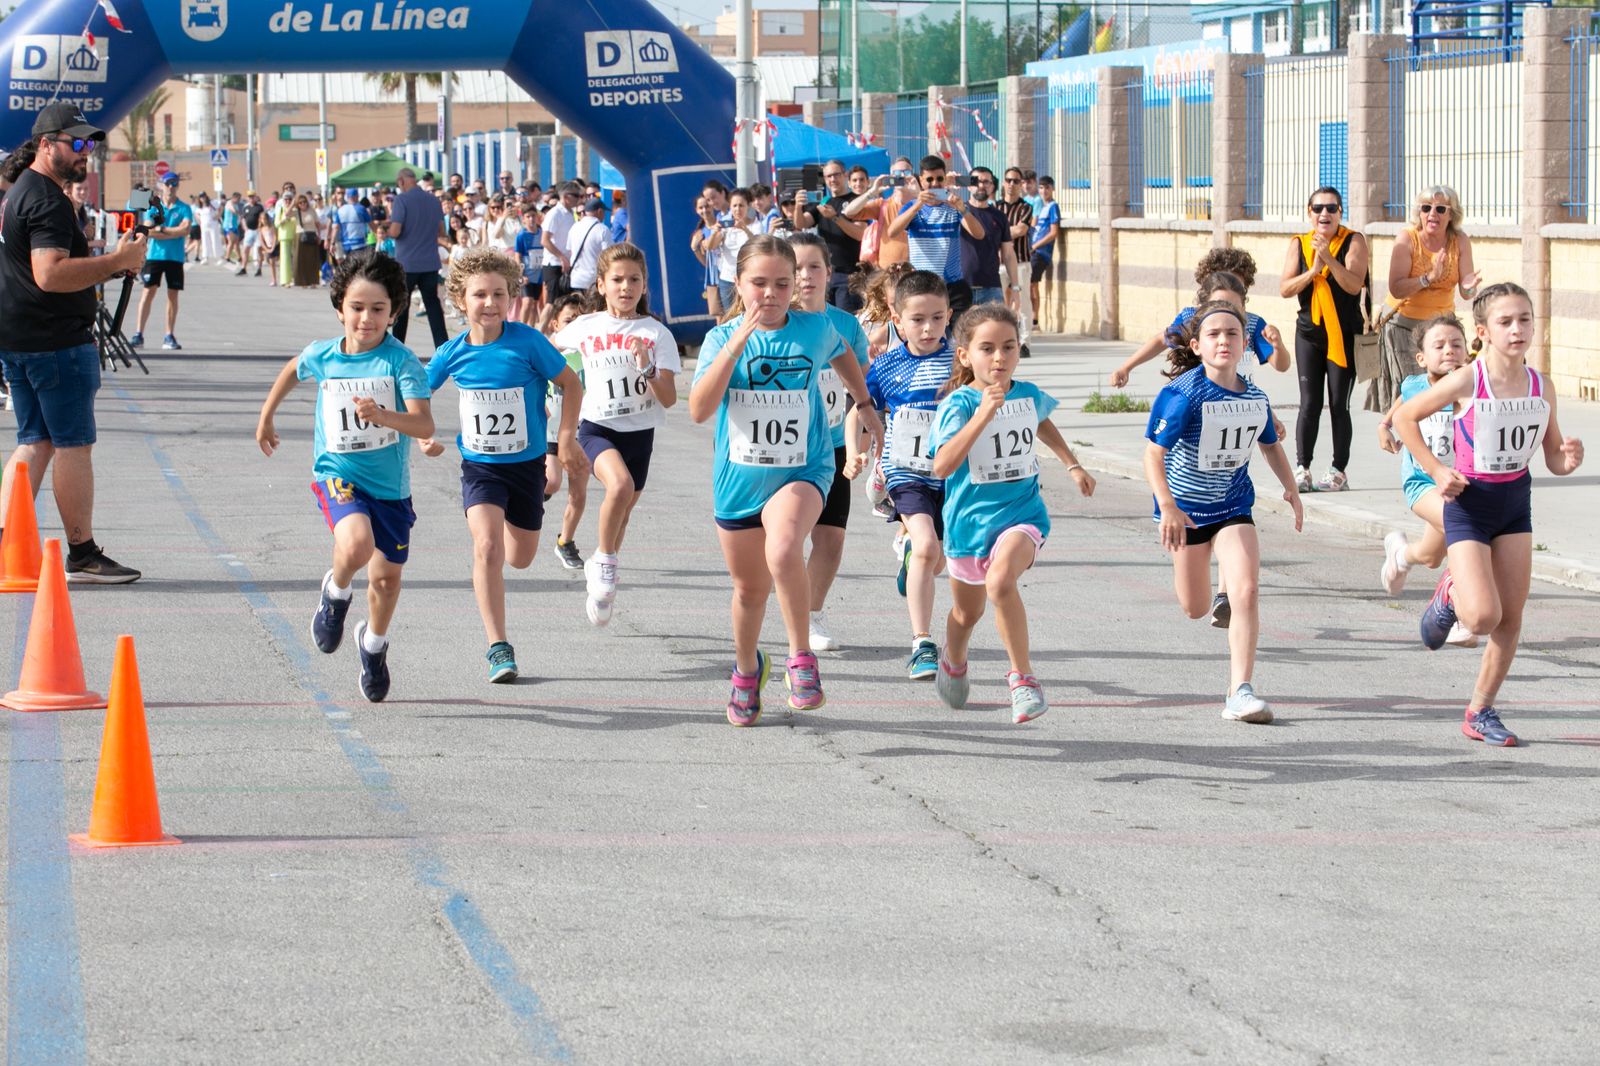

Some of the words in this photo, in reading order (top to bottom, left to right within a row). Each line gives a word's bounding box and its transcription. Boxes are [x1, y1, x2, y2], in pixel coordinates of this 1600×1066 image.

[269, 2, 313, 33] de
[320, 3, 364, 32] La
[371, 0, 470, 31] Línea
[23, 45, 48, 70] D
[597, 41, 621, 68] D
[75, 84, 89, 93] DE
[588, 75, 650, 88] DELEGACIÓN
[651, 75, 665, 84] DE
[589, 87, 684, 107] DEPORTES
[606, 374, 649, 400] 116
[752, 393, 805, 405] MILLA
[1221, 402, 1262, 414] MILLA
[1500, 399, 1546, 412] MILLA
[472, 412, 517, 436] 122
[749, 419, 799, 446] 105
[990, 427, 1034, 460] 129
[1217, 425, 1259, 451] 117
[1496, 424, 1540, 452] 107
